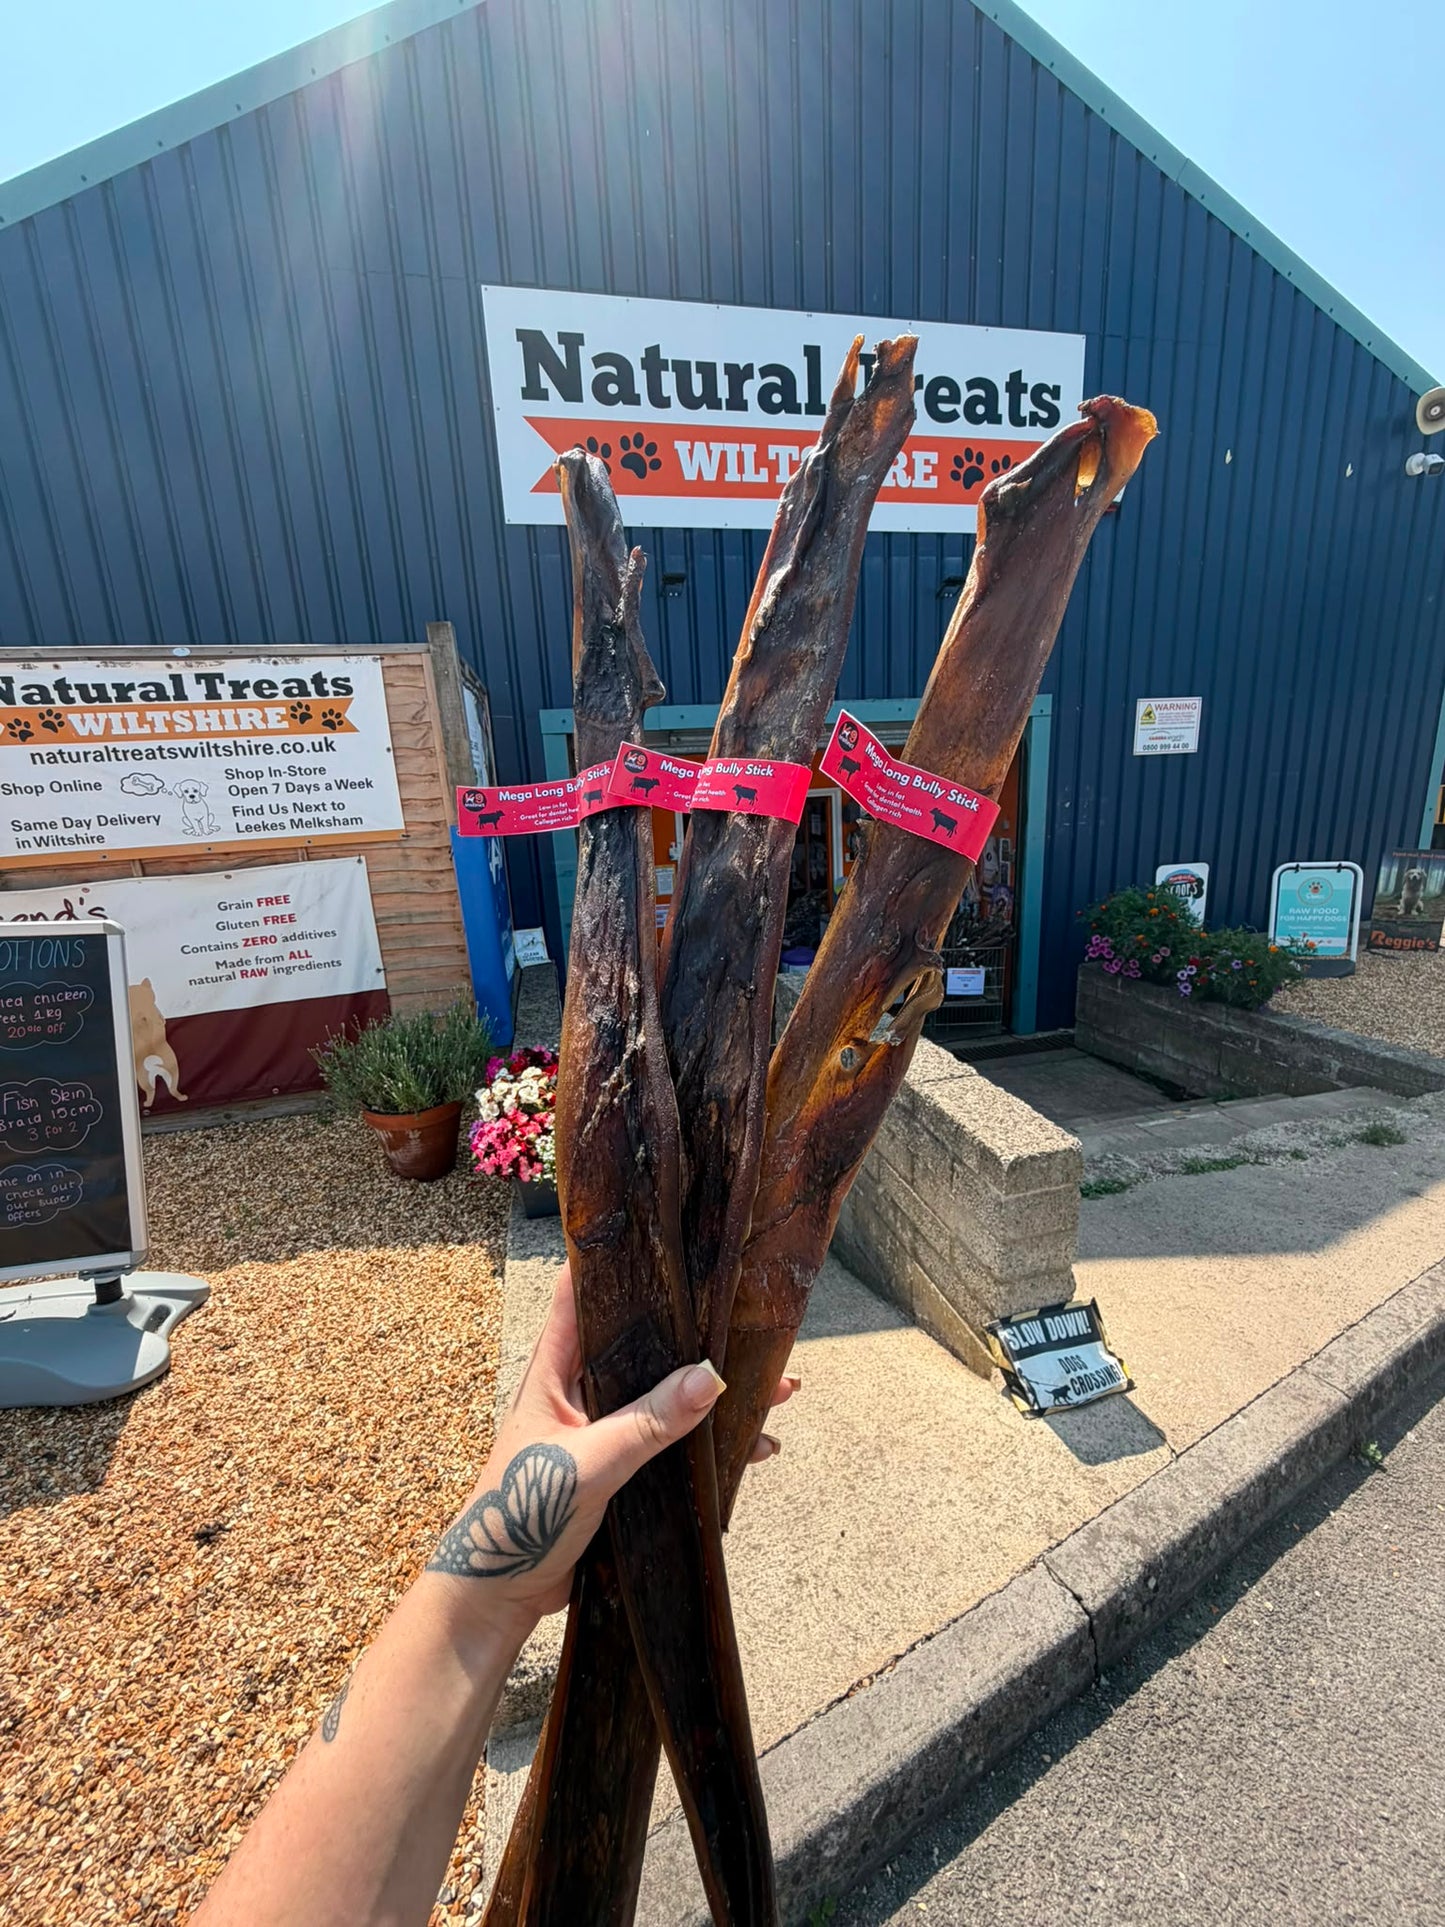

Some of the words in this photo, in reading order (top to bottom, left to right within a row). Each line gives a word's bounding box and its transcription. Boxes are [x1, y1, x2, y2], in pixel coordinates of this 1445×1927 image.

[515, 328, 826, 416] Natural
[674, 440, 938, 488] WILTRE
[194, 671, 353, 701] Treats
[1154, 702, 1197, 711] WARNING
[67, 707, 290, 737] WILTSHIRE
[30, 736, 337, 765] naturaltreatswiltshire.co.uk
[224, 767, 264, 782] Shop
[268, 765, 327, 779] In-Store
[660, 759, 696, 778] Mega
[715, 763, 742, 777] Bully
[745, 764, 774, 777] Stick
[865, 741, 884, 769] Mega
[882, 761, 911, 786] Long
[912, 774, 946, 800] Bully
[947, 788, 981, 812] Stick
[1, 782, 45, 797] Shop
[50, 780, 103, 794] Online
[228, 783, 268, 798] Open
[273, 783, 280, 795] 7
[285, 781, 321, 795] Days
[324, 781, 333, 791] a
[334, 778, 374, 791] Week
[498, 790, 533, 804] Mega
[535, 786, 564, 798] Long
[586, 765, 611, 782] Stick
[232, 804, 264, 818] Find
[269, 803, 289, 816] Us
[292, 802, 327, 814] Next
[331, 800, 346, 811] to
[879, 795, 901, 809] dental
[10, 819, 58, 833] Same
[62, 816, 92, 831] Day
[96, 813, 161, 828] Delivery
[235, 820, 287, 834] Leekes
[290, 815, 363, 830] Melksham
[15, 837, 32, 849] in
[33, 833, 105, 849] Wiltshire
[217, 899, 254, 912] Grain
[256, 894, 291, 907] FREE
[1313, 907, 1340, 915] FOOD
[215, 919, 260, 932] Gluten
[262, 913, 297, 926] FREE
[180, 941, 239, 955] Contains
[242, 934, 277, 948] ZERO
[281, 928, 338, 943] additives
[1370, 930, 1437, 950] Reggie's
[215, 957, 252, 971] Made
[255, 953, 285, 966] from
[288, 949, 313, 961] ALL
[188, 971, 237, 986] natural
[239, 967, 269, 980] RAW
[272, 958, 342, 976] ingredients
[4, 1090, 39, 1115] Fish
[50, 1087, 86, 1105] Skin
[27, 1127, 39, 1141] 3
[45, 1125, 63, 1139] for
[68, 1121, 78, 1133] 2
[26, 1172, 42, 1183] on
[50, 1170, 64, 1180] in
[51, 1181, 75, 1194] out
[6, 1199, 29, 1212] our
[1003, 1319, 1047, 1351] SLOW
[1044, 1310, 1092, 1342] DOWN!
[1057, 1354, 1089, 1375] DOGS
[1069, 1362, 1125, 1397] CROSSING!
